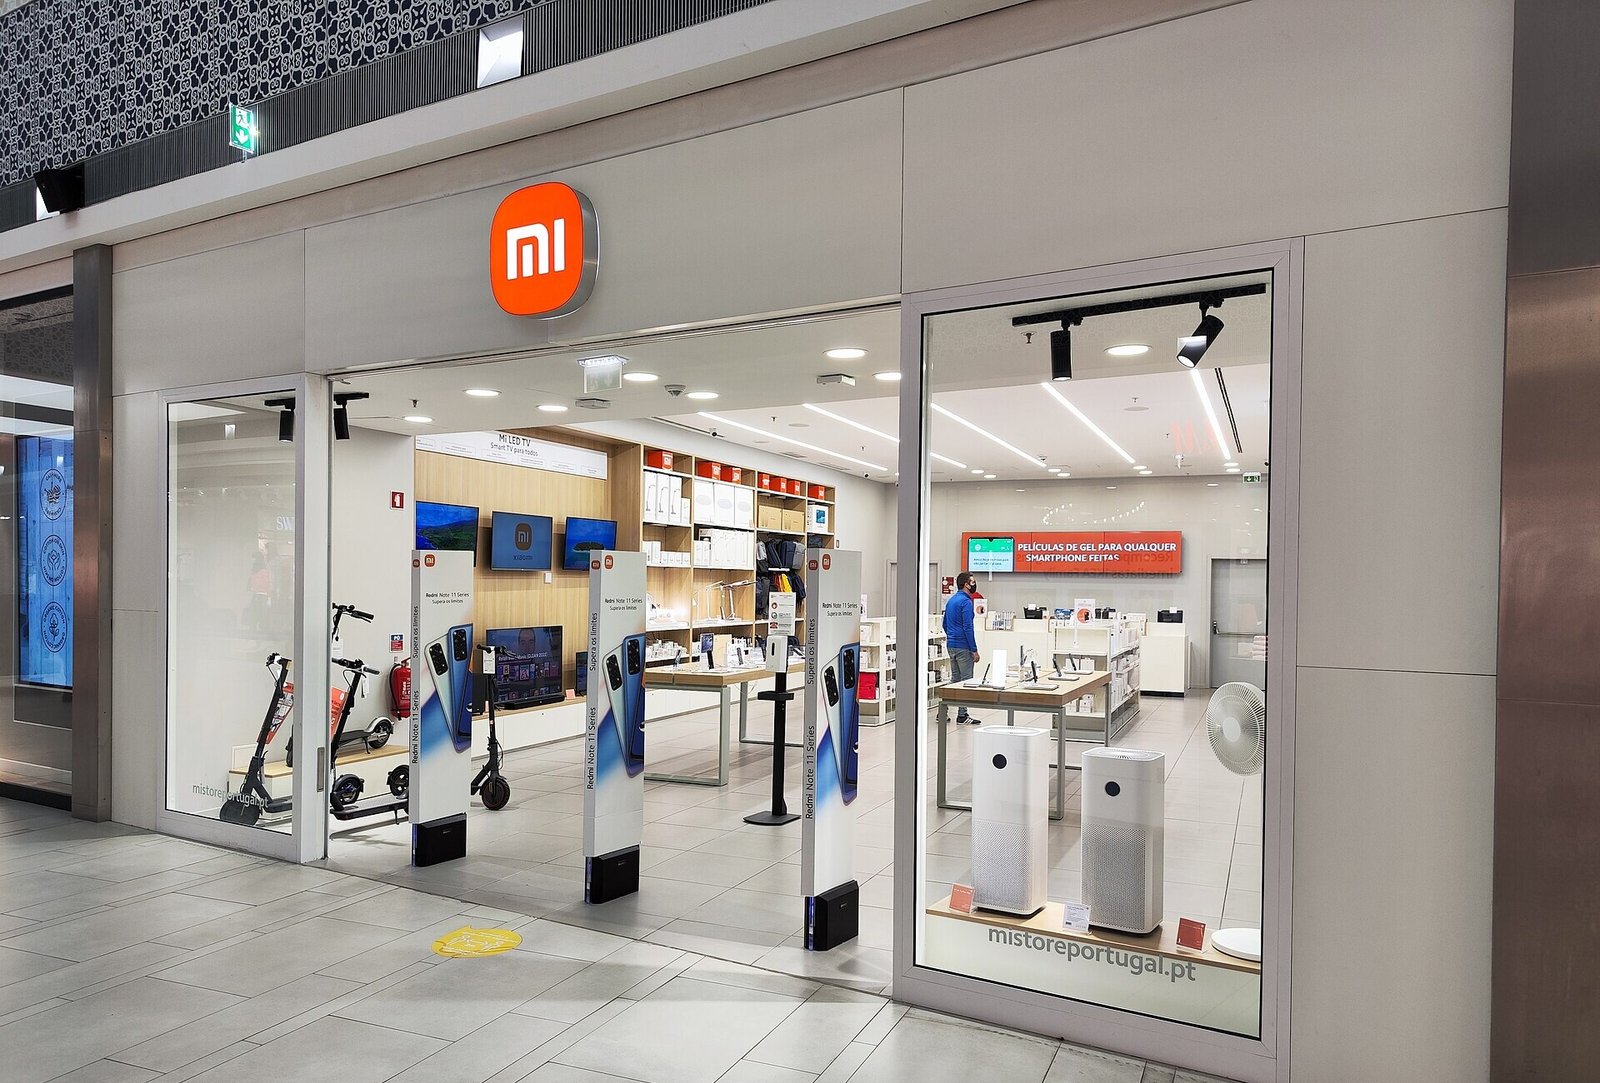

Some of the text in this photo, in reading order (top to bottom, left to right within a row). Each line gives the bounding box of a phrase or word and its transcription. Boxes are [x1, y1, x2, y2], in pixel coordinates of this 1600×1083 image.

[498, 434, 531, 448] Mi LED TV
[490, 442, 505, 452] Smart
[505, 444, 514, 452] TV
[514, 446, 524, 456] para
[525, 448, 538, 457] todos
[1018, 541, 1176, 552] PELÍCULAS DE GEL PARA QUALQUER
[1026, 554, 1088, 562] SMARTPHONE
[413, 630, 419, 638] os
[592, 638, 597, 646] os
[809, 647, 814, 656] os
[412, 712, 419, 720] 11
[589, 733, 595, 742] 11
[807, 755, 814, 764] 11
[192, 784, 269, 810] mistoreportugal.pt
[988, 926, 1196, 982] mistoreportugal.pt
